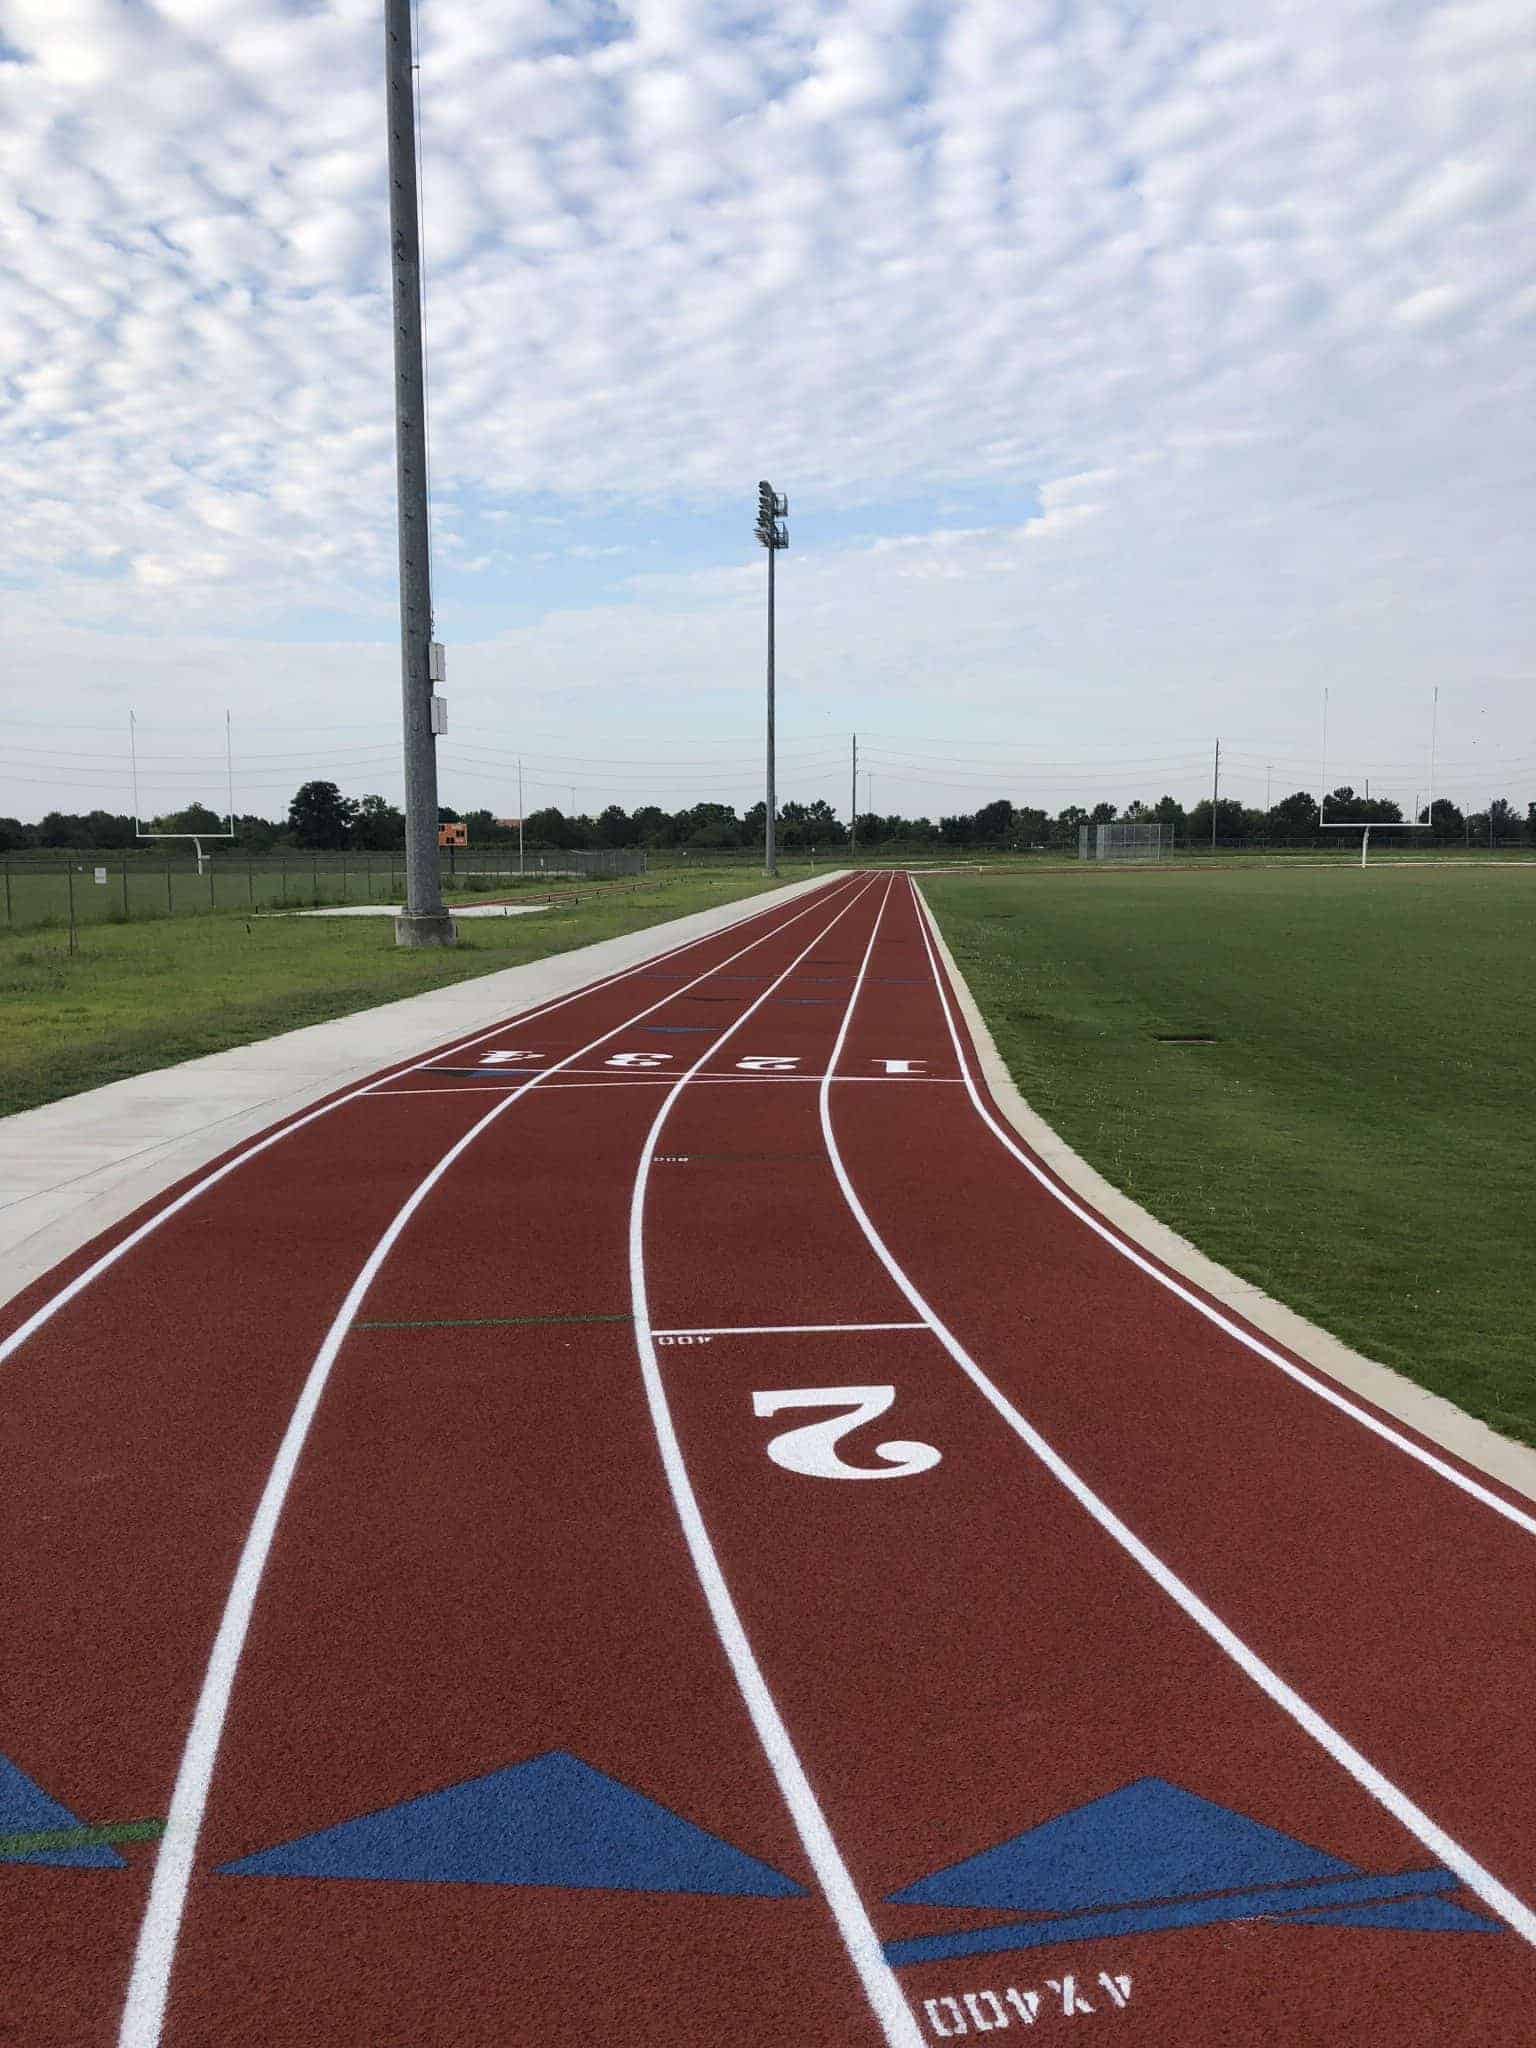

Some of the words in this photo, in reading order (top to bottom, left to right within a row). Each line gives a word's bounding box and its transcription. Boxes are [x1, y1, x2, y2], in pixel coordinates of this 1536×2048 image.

[478, 1049, 546, 1065] 4
[604, 1052, 674, 1067] 3
[736, 1056, 801, 1071] 2
[871, 1058, 928, 1074] 1
[656, 1335, 714, 1347] 400
[751, 1384, 943, 1480] 2
